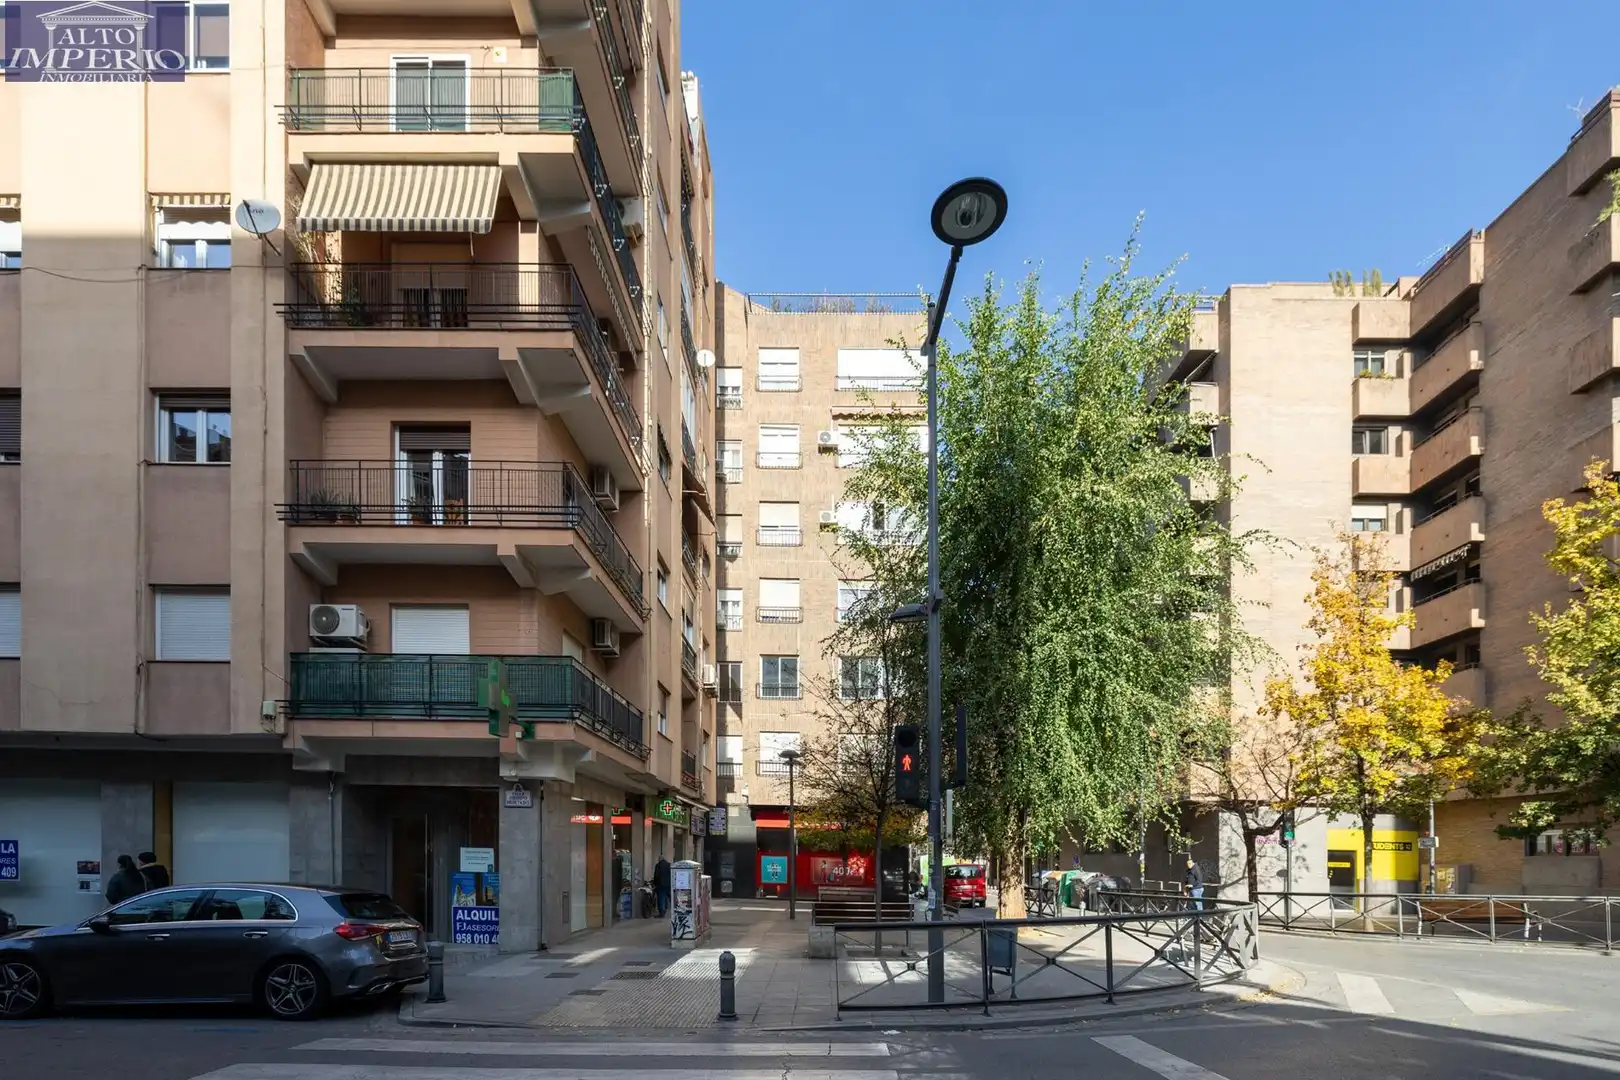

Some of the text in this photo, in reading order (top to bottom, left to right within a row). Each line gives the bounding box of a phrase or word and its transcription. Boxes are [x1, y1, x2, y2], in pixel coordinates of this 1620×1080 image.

[1, 866, 17, 877] 409
[456, 933, 472, 944] 958
[473, 933, 490, 944] 010
